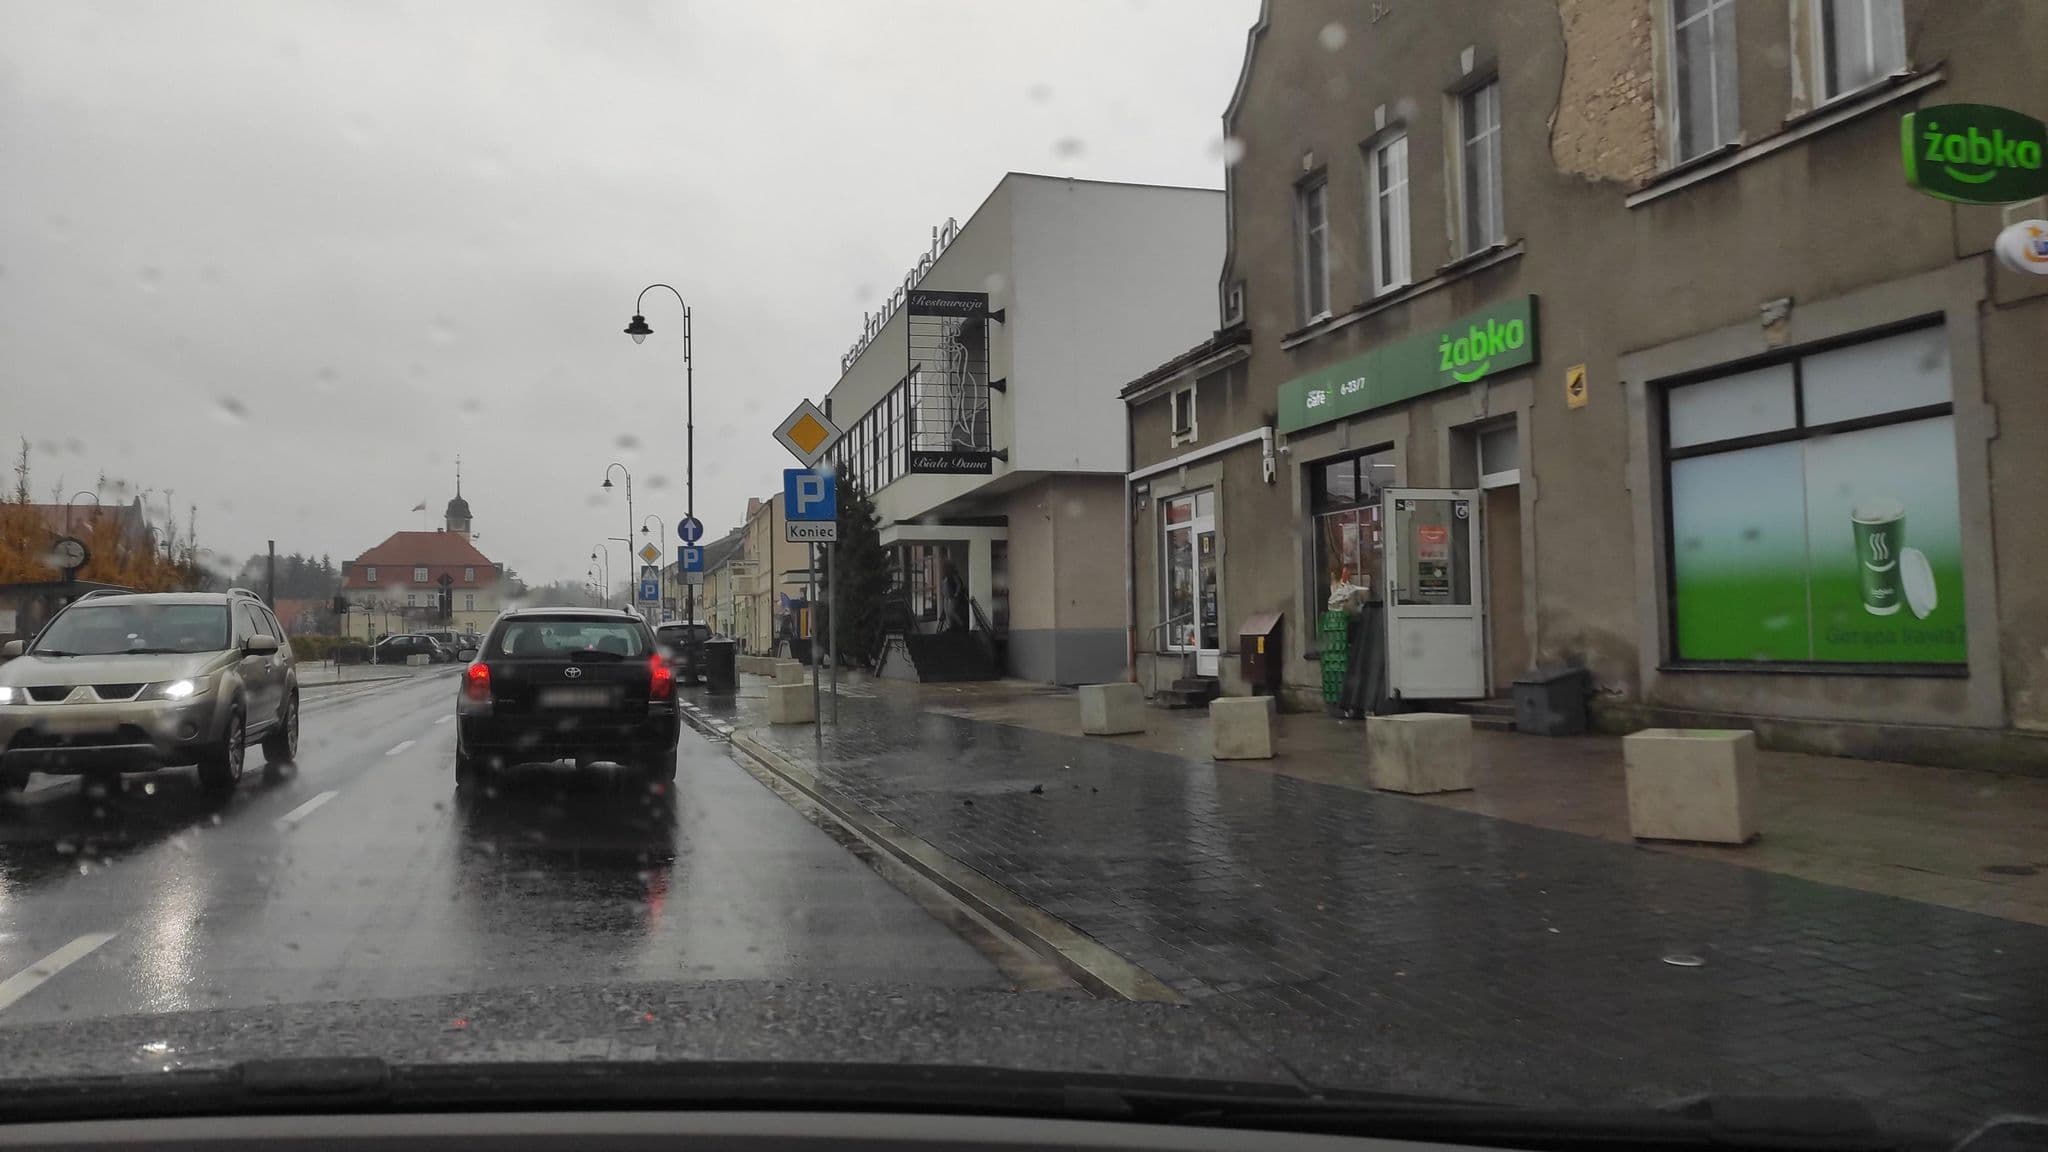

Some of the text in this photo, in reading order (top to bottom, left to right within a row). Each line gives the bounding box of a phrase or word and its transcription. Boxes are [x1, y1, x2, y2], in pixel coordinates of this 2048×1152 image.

[911, 295, 983, 312] Restauracja
[796, 475, 825, 513] P
[790, 525, 834, 537] Koniec
[683, 549, 699, 569] P
[645, 584, 656, 598] P
